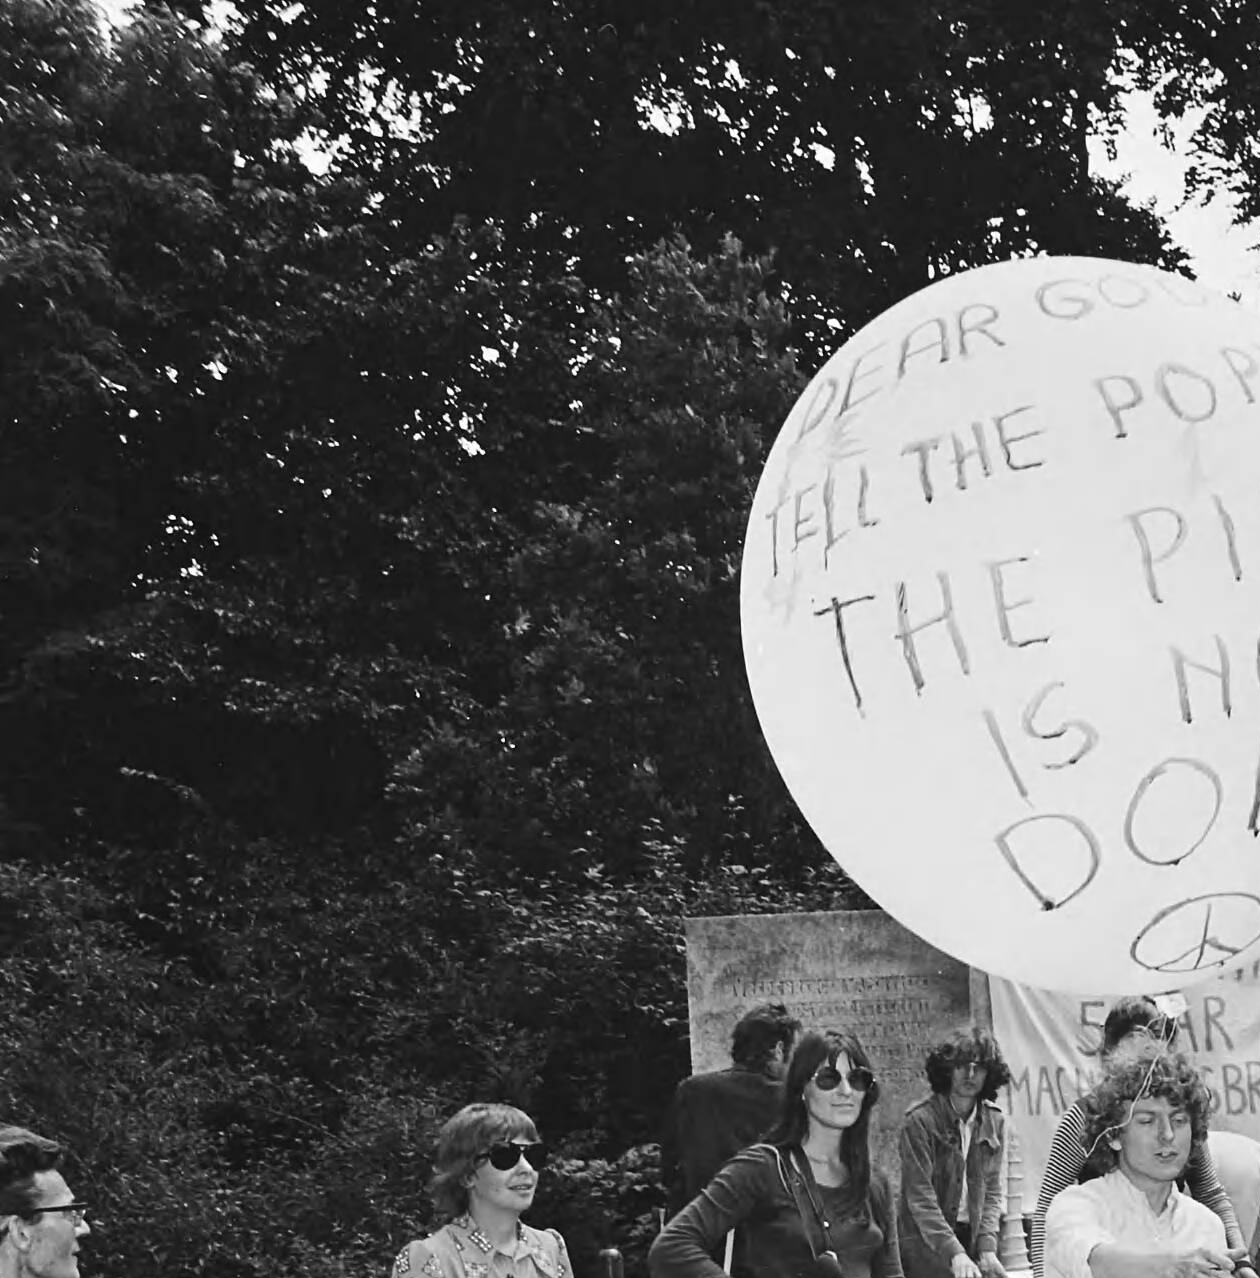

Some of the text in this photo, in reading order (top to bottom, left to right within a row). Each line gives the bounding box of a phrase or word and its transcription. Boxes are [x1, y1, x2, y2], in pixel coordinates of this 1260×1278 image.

[798, 303, 1006, 440] DEAR
[764, 462, 880, 577] TELL
[900, 404, 1046, 504] THE
[812, 555, 1051, 716] THE
[982, 681, 1099, 806] IS
